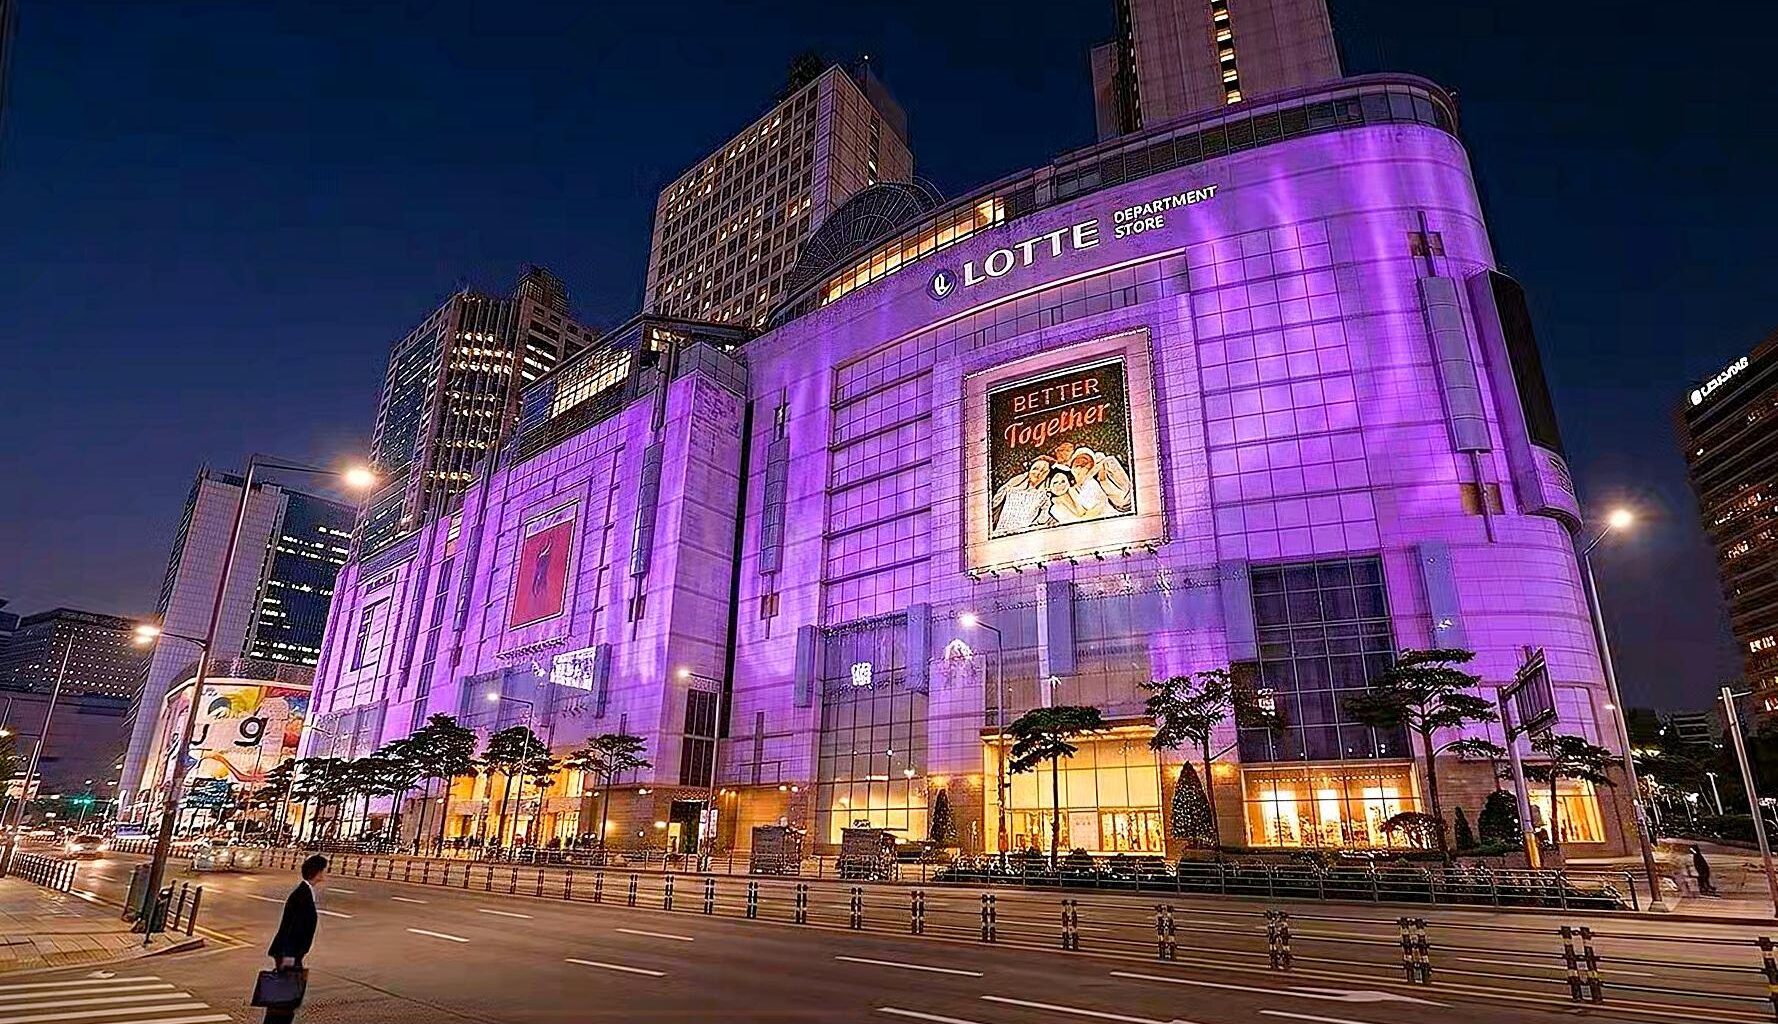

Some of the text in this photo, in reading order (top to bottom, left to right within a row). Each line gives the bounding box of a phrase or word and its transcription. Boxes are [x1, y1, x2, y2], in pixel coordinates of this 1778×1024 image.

[1113, 185, 1218, 224] DEPARTMENT
[1113, 214, 1165, 240] STORE
[962, 219, 1100, 288] LOTTE
[1013, 378, 1100, 413] BETTER
[1004, 401, 1110, 449] Together
